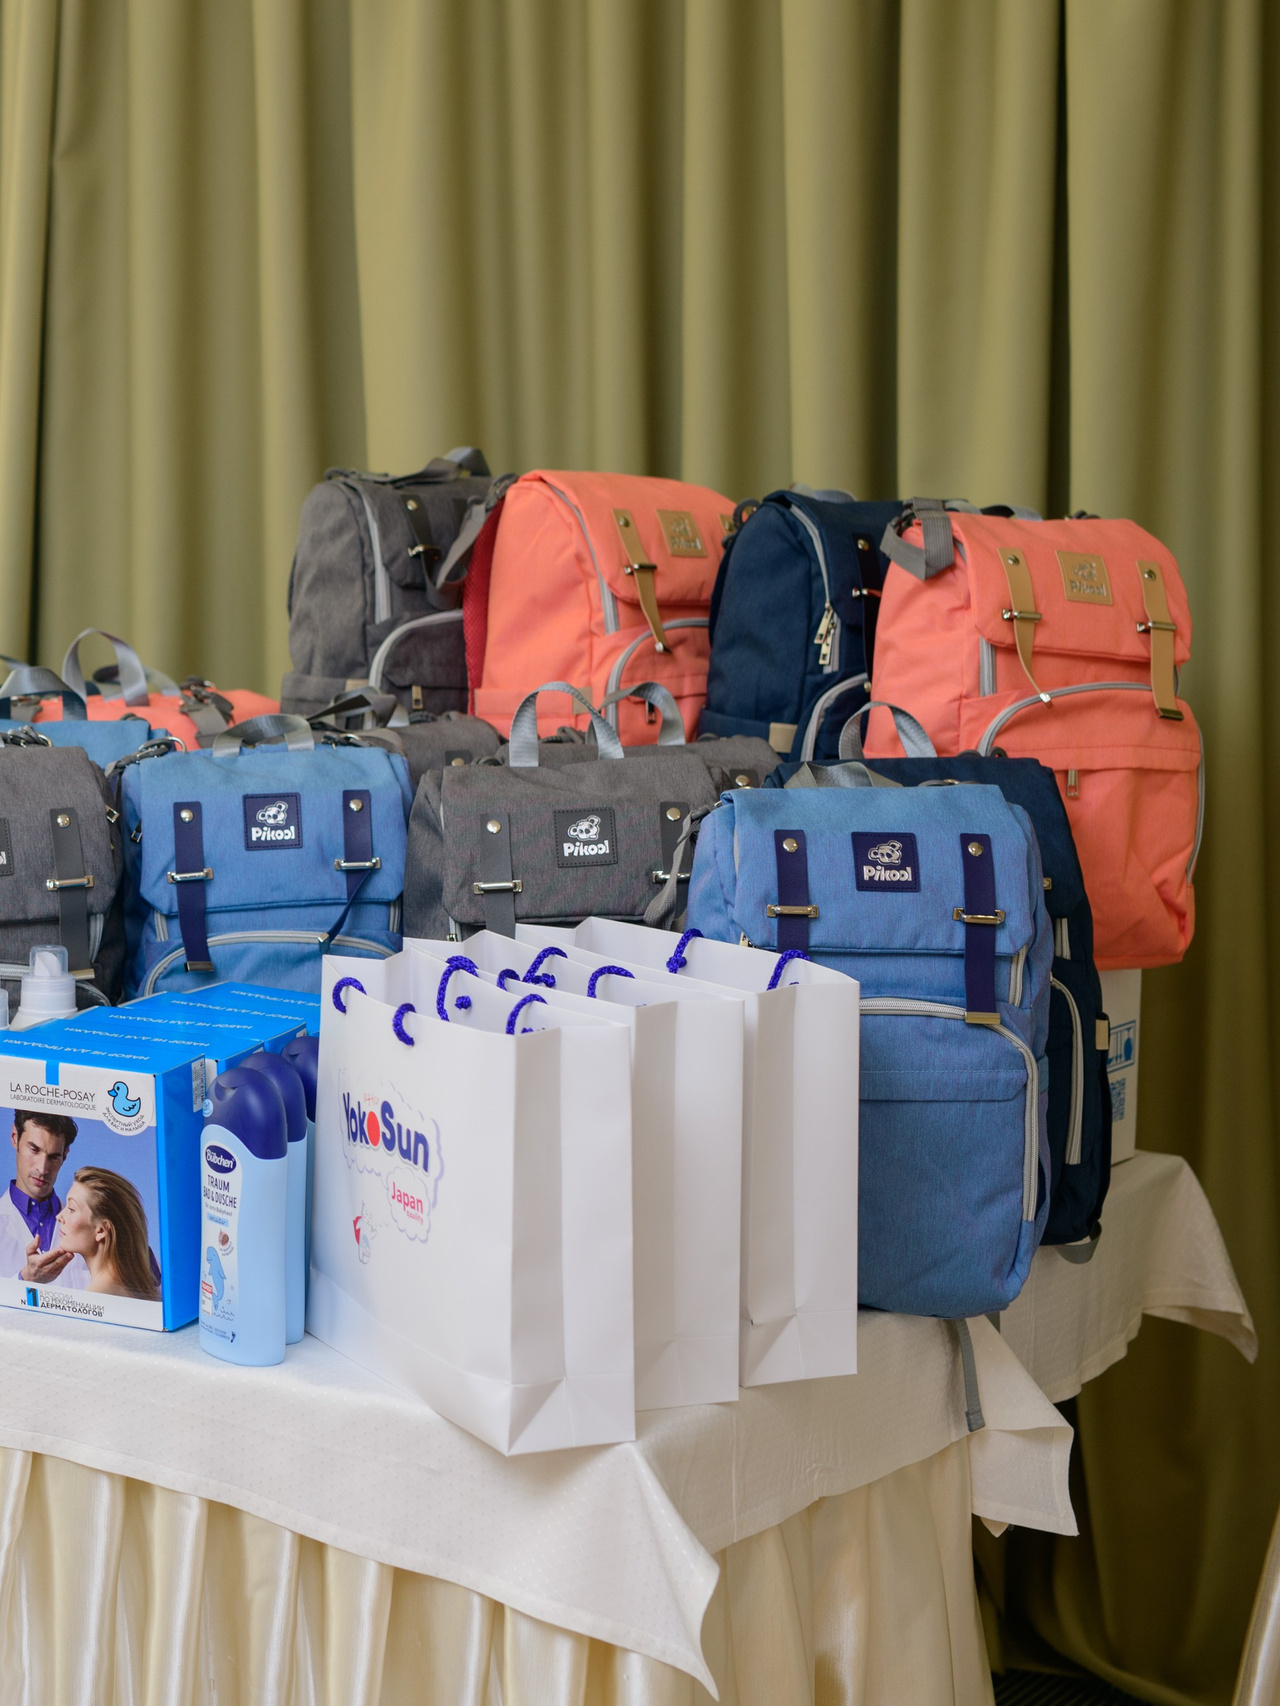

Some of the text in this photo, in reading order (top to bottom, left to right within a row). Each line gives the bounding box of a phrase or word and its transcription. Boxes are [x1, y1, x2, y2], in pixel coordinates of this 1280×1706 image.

[251, 825, 296, 842] Pikool
[562, 840, 610, 857] Pikool
[863, 865, 913, 882] Pikool
[3, 1038, 63, 1051] ПРОДАЖИ
[63, 1046, 92, 1054] ДЛЯ
[107, 1053, 150, 1061] НАБОР
[10, 1082, 96, 1102] LA ROCHE-POSAY
[10, 1094, 46, 1105] LABORATOIRE
[207, 1174, 230, 1193] TRAUM
[215, 1191, 237, 1209] DUSCHE
[391, 1181, 424, 1214] Japan
[28, 1288, 38, 1308] 1
[40, 1301, 104, 1318] ДЕРМАТОЛОГОВ
